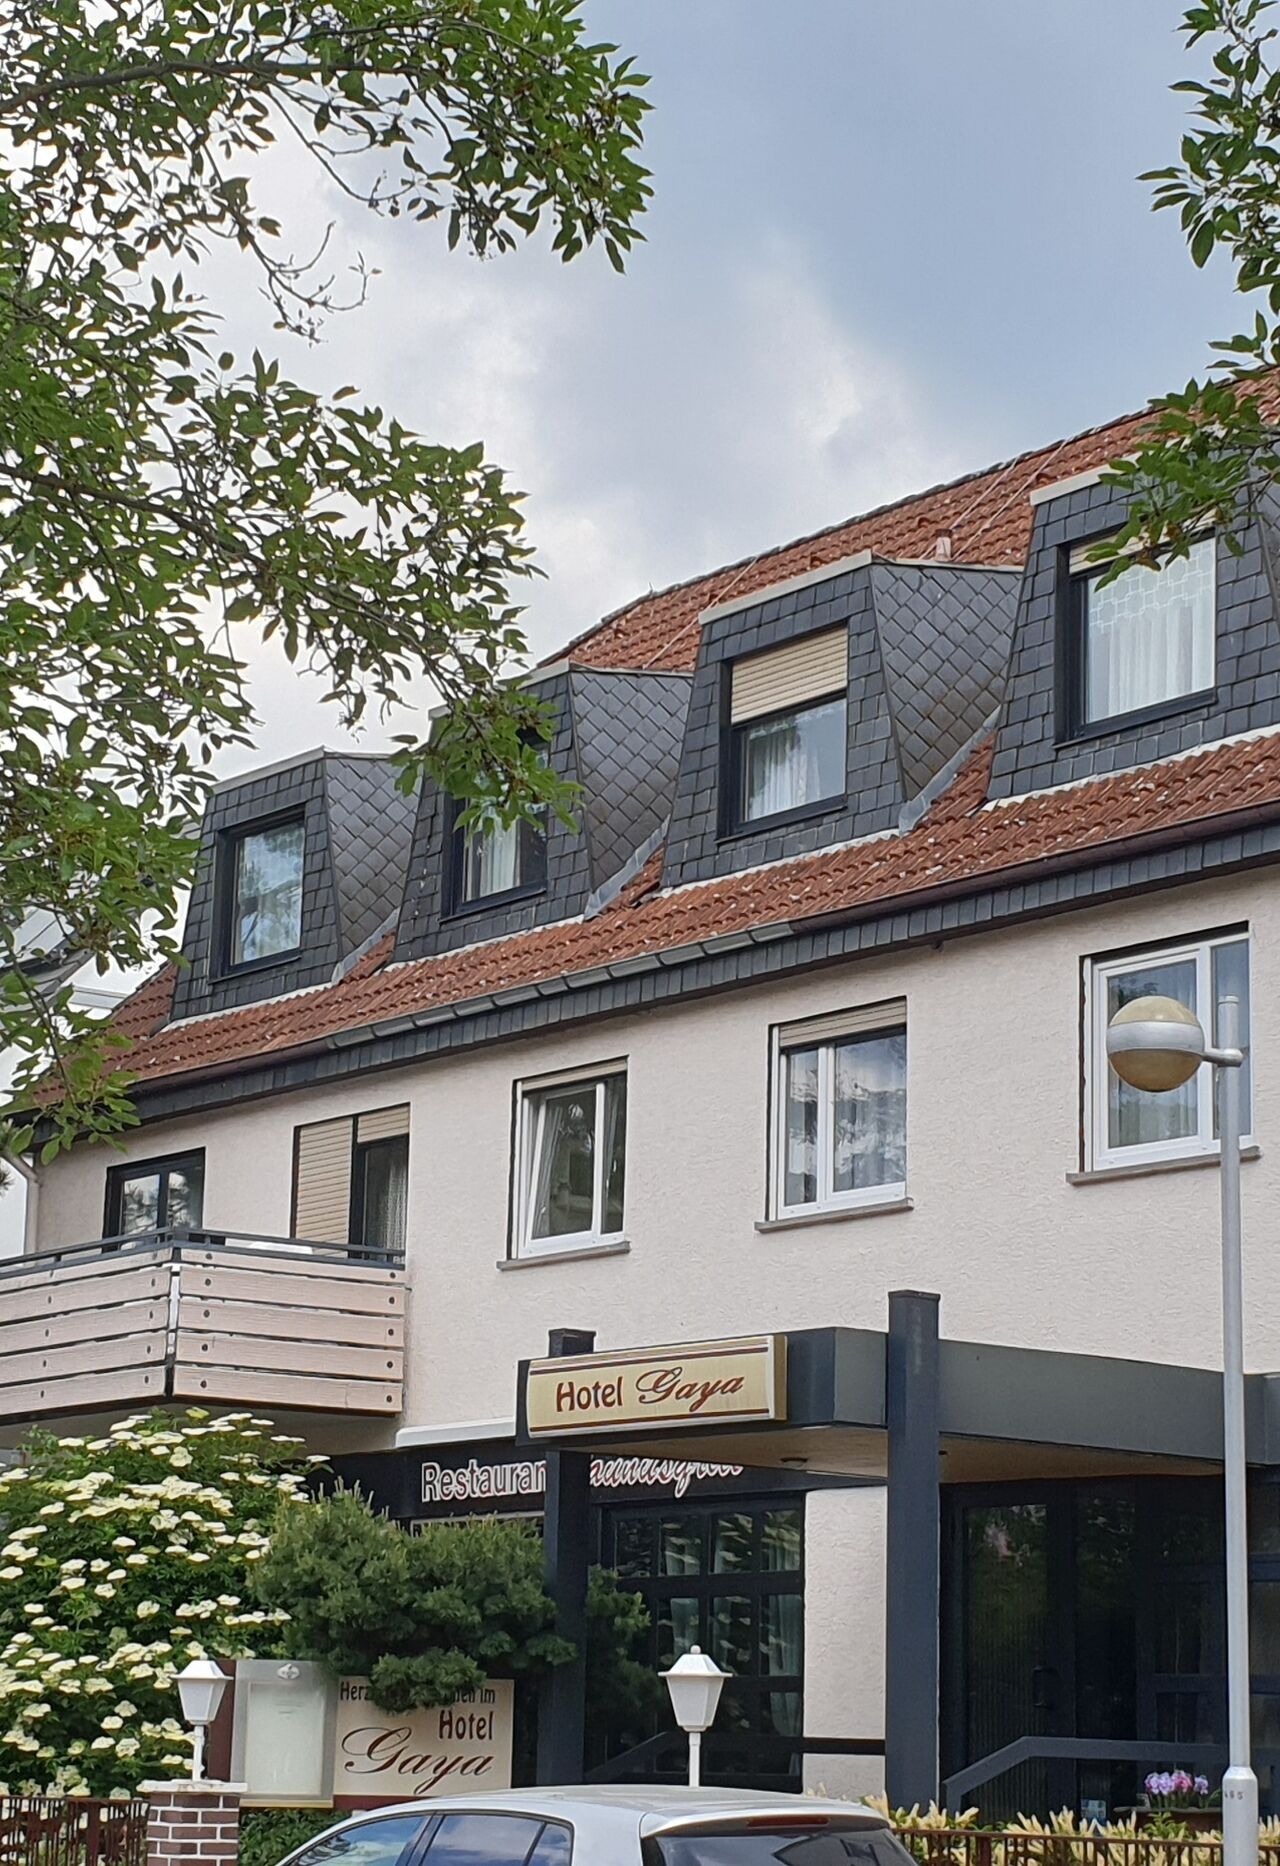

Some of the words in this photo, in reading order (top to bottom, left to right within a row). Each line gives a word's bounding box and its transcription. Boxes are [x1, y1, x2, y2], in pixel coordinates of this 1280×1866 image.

[556, 1376, 623, 1412] Hotel
[635, 1366, 745, 1412] Gaya
[421, 1459, 547, 1503] Restauran
[439, 1709, 494, 1740] Hotel
[341, 1726, 494, 1795] Gaya
